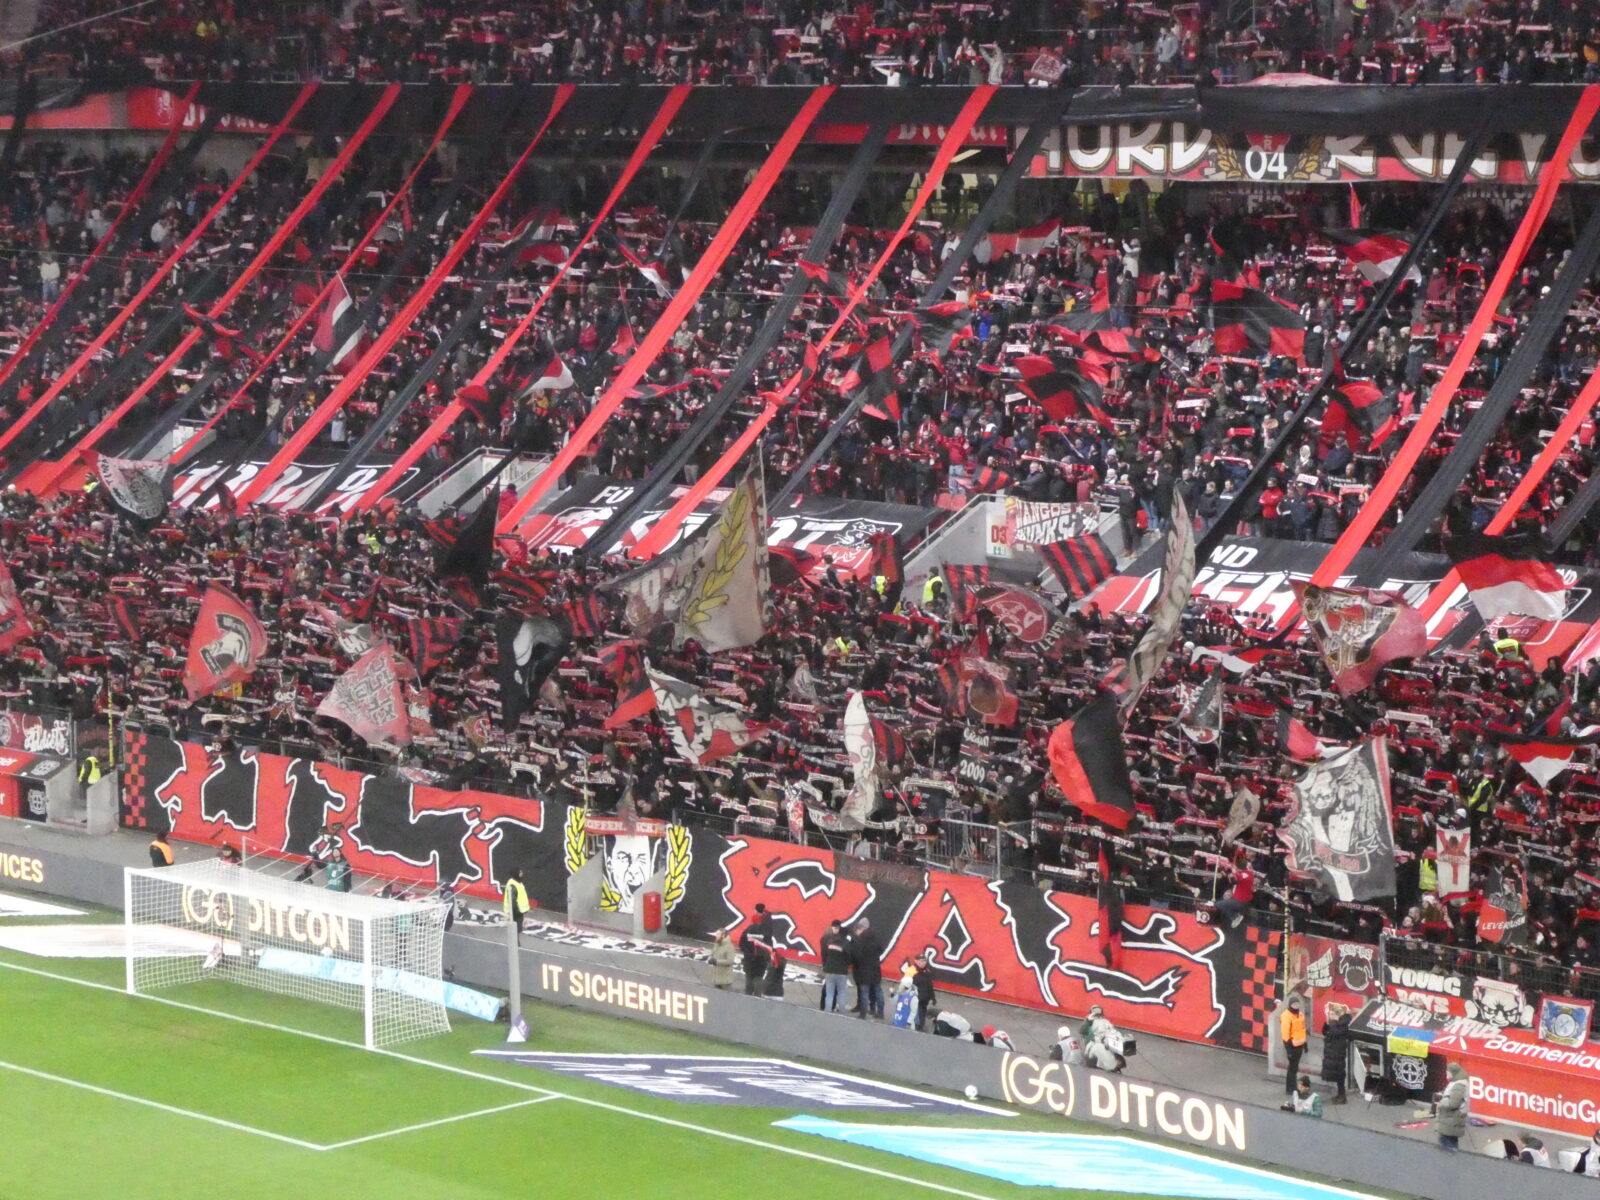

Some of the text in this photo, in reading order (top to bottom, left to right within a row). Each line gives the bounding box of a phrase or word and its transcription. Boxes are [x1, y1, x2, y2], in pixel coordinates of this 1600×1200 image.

[1245, 146, 1289, 181] 04
[1209, 543, 1259, 568] ND
[541, 963, 709, 1024] IT SICHERHEIT
[1388, 965, 1462, 997] YOUNG
[1090, 1074, 1246, 1151] DITCON
